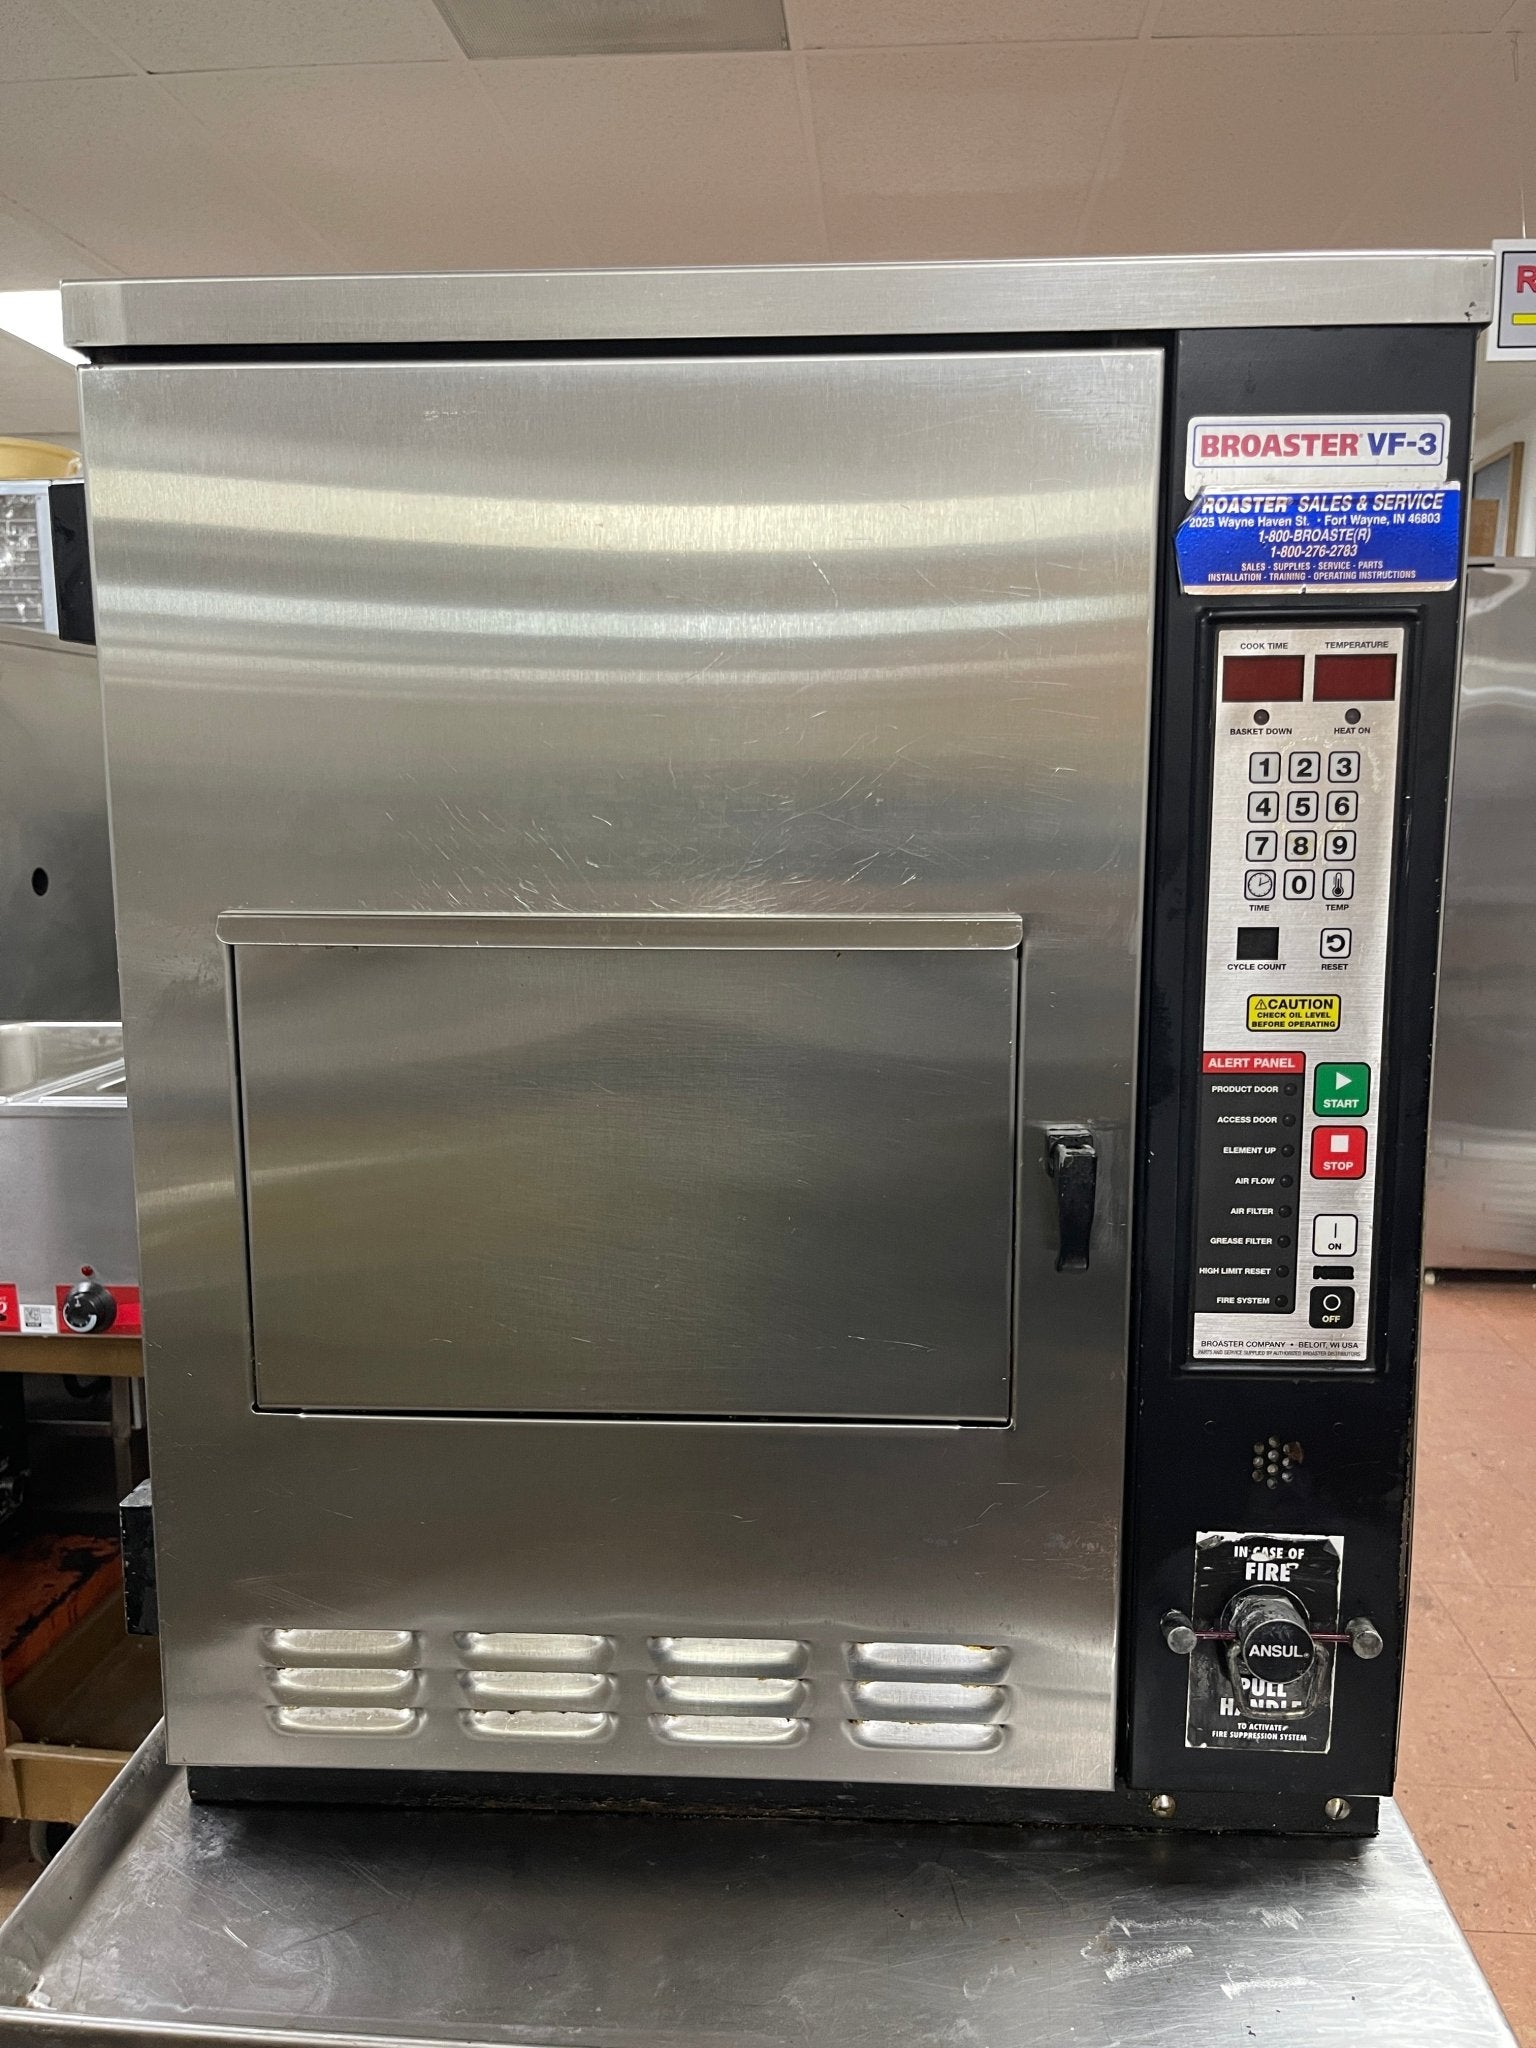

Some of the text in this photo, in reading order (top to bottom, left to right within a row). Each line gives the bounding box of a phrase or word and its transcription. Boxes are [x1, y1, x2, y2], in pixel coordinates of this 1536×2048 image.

[1201, 432, 1437, 458] BROASTER VF-3
[1298, 495, 1353, 512] SALES
[1356, 495, 1368, 511] &
[1372, 493, 1445, 511] SERVICE
[1189, 517, 1215, 528] 2025
[1218, 517, 1255, 530] Wayne
[1257, 516, 1292, 527] Haven
[1295, 515, 1310, 527] St.
[1324, 515, 1347, 526] Fort
[1350, 514, 1390, 527] Wayne,
[1393, 513, 1405, 524] IN
[1408, 513, 1441, 524] 46803
[1259, 529, 1372, 544] 1-800-BROASTE(R)
[1270, 545, 1358, 558] 1-800-276-2783
[1242, 563, 1265, 571] SALES
[1273, 562, 1311, 571] SUPPLIES
[1318, 562, 1350, 570] SERVICE
[1358, 561, 1383, 569] PARTS
[1208, 573, 1261, 582] INSTALLATION
[1269, 572, 1306, 581] TRAINING
[1313, 571, 1356, 580] OPERATING
[1359, 570, 1416, 579] INSTRUCTIONS
[1267, 642, 1288, 650] TIME
[1325, 641, 1389, 649] TEMPERATURE
[1230, 728, 1263, 736] BASKET
[1334, 727, 1370, 735] HEAT ON
[1260, 758, 1269, 777] 1
[1297, 758, 1312, 777] 2
[1336, 758, 1352, 776] 3
[1256, 798, 1271, 816] 4
[1295, 798, 1310, 816] 5
[1334, 797, 1350, 815] 6
[1255, 837, 1269, 855] 7
[1293, 837, 1308, 855] 8
[1332, 836, 1348, 855] 9
[1292, 876, 1307, 894] 0
[1249, 904, 1270, 912] TIME
[1268, 999, 1333, 1010] CAUTION
[1208, 1058, 1295, 1068] ALERT PANEL
[1323, 1100, 1359, 1108] START
[1217, 1116, 1278, 1124] ACCESS DOOR
[1323, 1162, 1353, 1170] STOP
[1210, 1237, 1243, 1245] GREASE
[1199, 1267, 1220, 1275] HIGH
[1322, 1315, 1341, 1323] OFF
[1234, 1546, 1305, 1560] IN CASE OF
[1245, 1562, 1291, 1582] FIRE
[1249, 1645, 1303, 1658] ANSUL
[1241, 1678, 1287, 1698] PULL
[1238, 1722, 1282, 1731] TO ACTIVATE
[1230, 1731, 1277, 1740] SUPPRESSION
